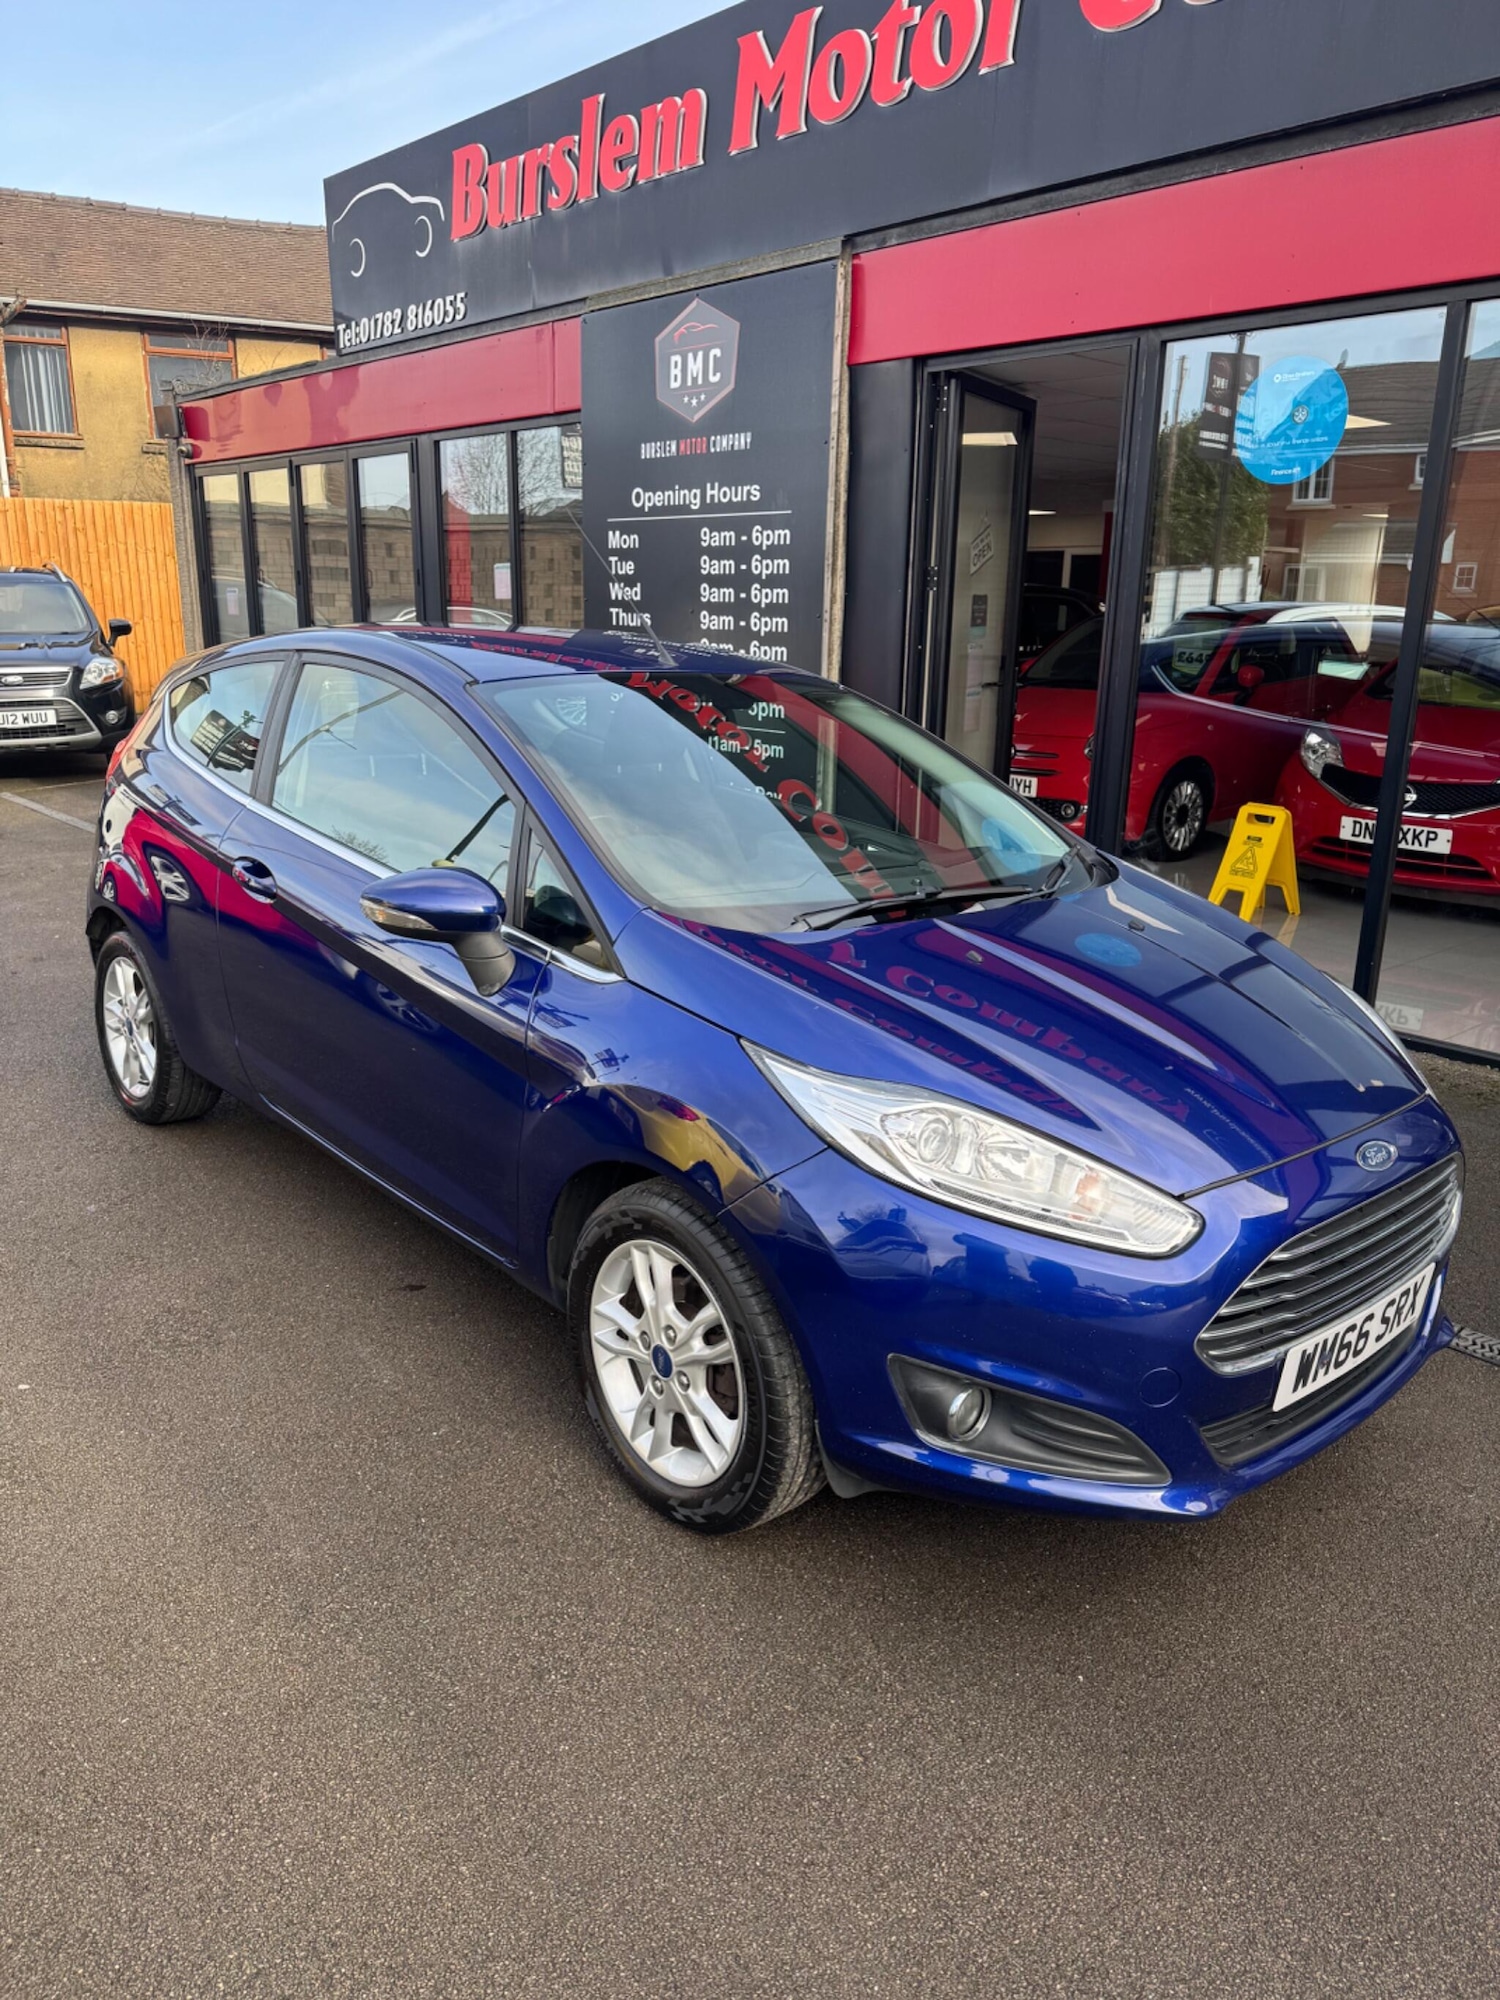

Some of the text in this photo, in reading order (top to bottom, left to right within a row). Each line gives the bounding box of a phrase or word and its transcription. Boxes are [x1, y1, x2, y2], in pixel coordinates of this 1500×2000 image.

[451, 0, 1015, 243] Burslem Motor
[407, 292, 467, 332] 816055
[669, 348, 722, 389] BMC
[641, 432, 752, 459] BURSLEM MOTOR COMPANY
[631, 483, 761, 512] Opening Hours
[608, 530, 639, 549] Mon
[700, 527, 735, 547] 9am
[752, 525, 791, 550] 6pm
[608, 556, 635, 575] Tue
[700, 555, 735, 575] 9am
[751, 554, 790, 579] 6pm
[609, 582, 641, 601] Wed
[700, 583, 735, 602] 9am
[750, 583, 789, 608] 6pm
[609, 608, 652, 627] Thurs
[699, 610, 734, 630] 9am
[750, 612, 788, 637] 6pm
[21, 711, 49, 725] WUU
[753, 739, 784, 760] 5pm
[1364, 1146, 1388, 1166] Ford
[1292, 1275, 1426, 1394] WM66 SRX
